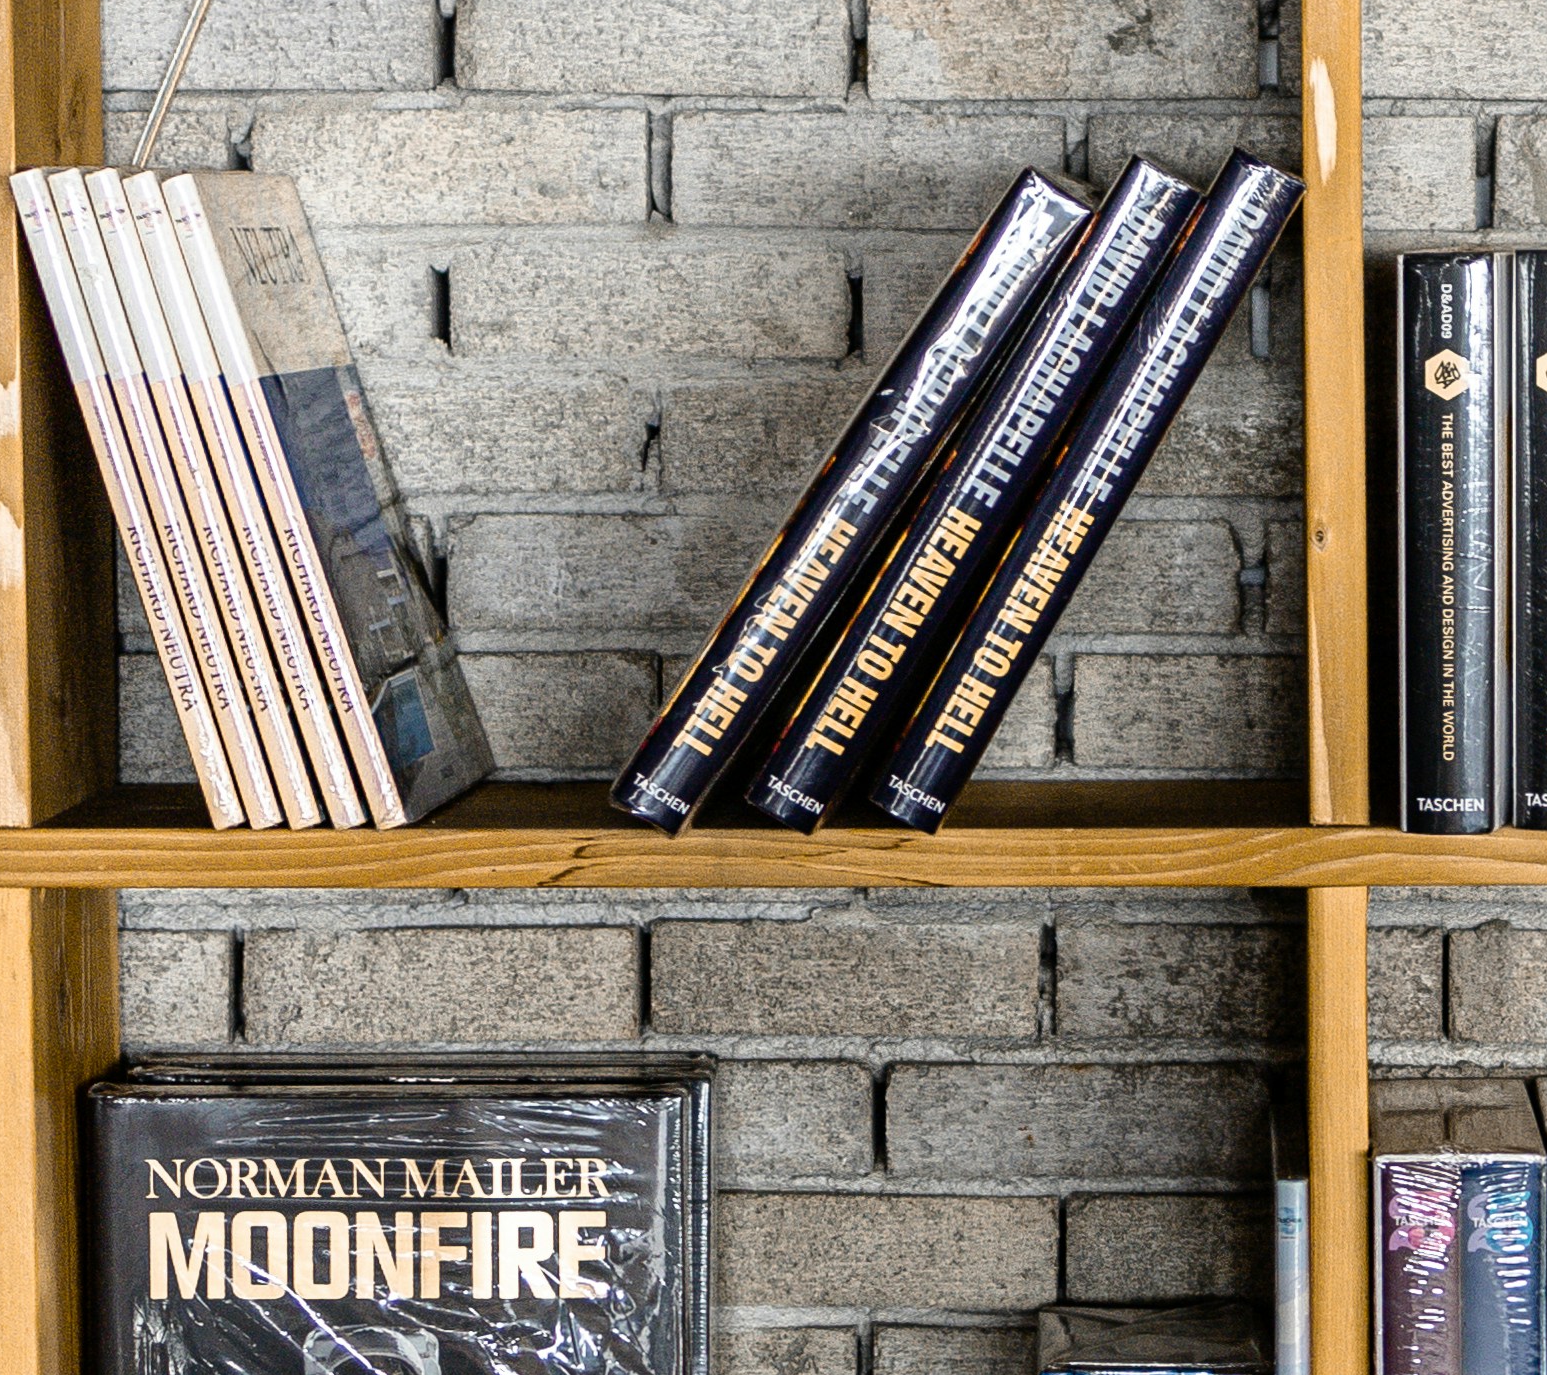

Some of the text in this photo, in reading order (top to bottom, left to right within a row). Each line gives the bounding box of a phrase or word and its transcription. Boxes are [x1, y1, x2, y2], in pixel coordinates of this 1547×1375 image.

[1440, 283, 1453, 339] D&AD09
[1442, 412, 1455, 761] THE BEST ADVERTISING AND DESIGN IN THE WORLD
[805, 505, 983, 757] HEAVEN TO HELL
[766, 775, 825, 817] TASCHEN
[1416, 798, 1485, 812] TASCHEN
[144, 1157, 612, 1201] NORMAN MAILER
[148, 1210, 609, 1301] MOONFIRE
